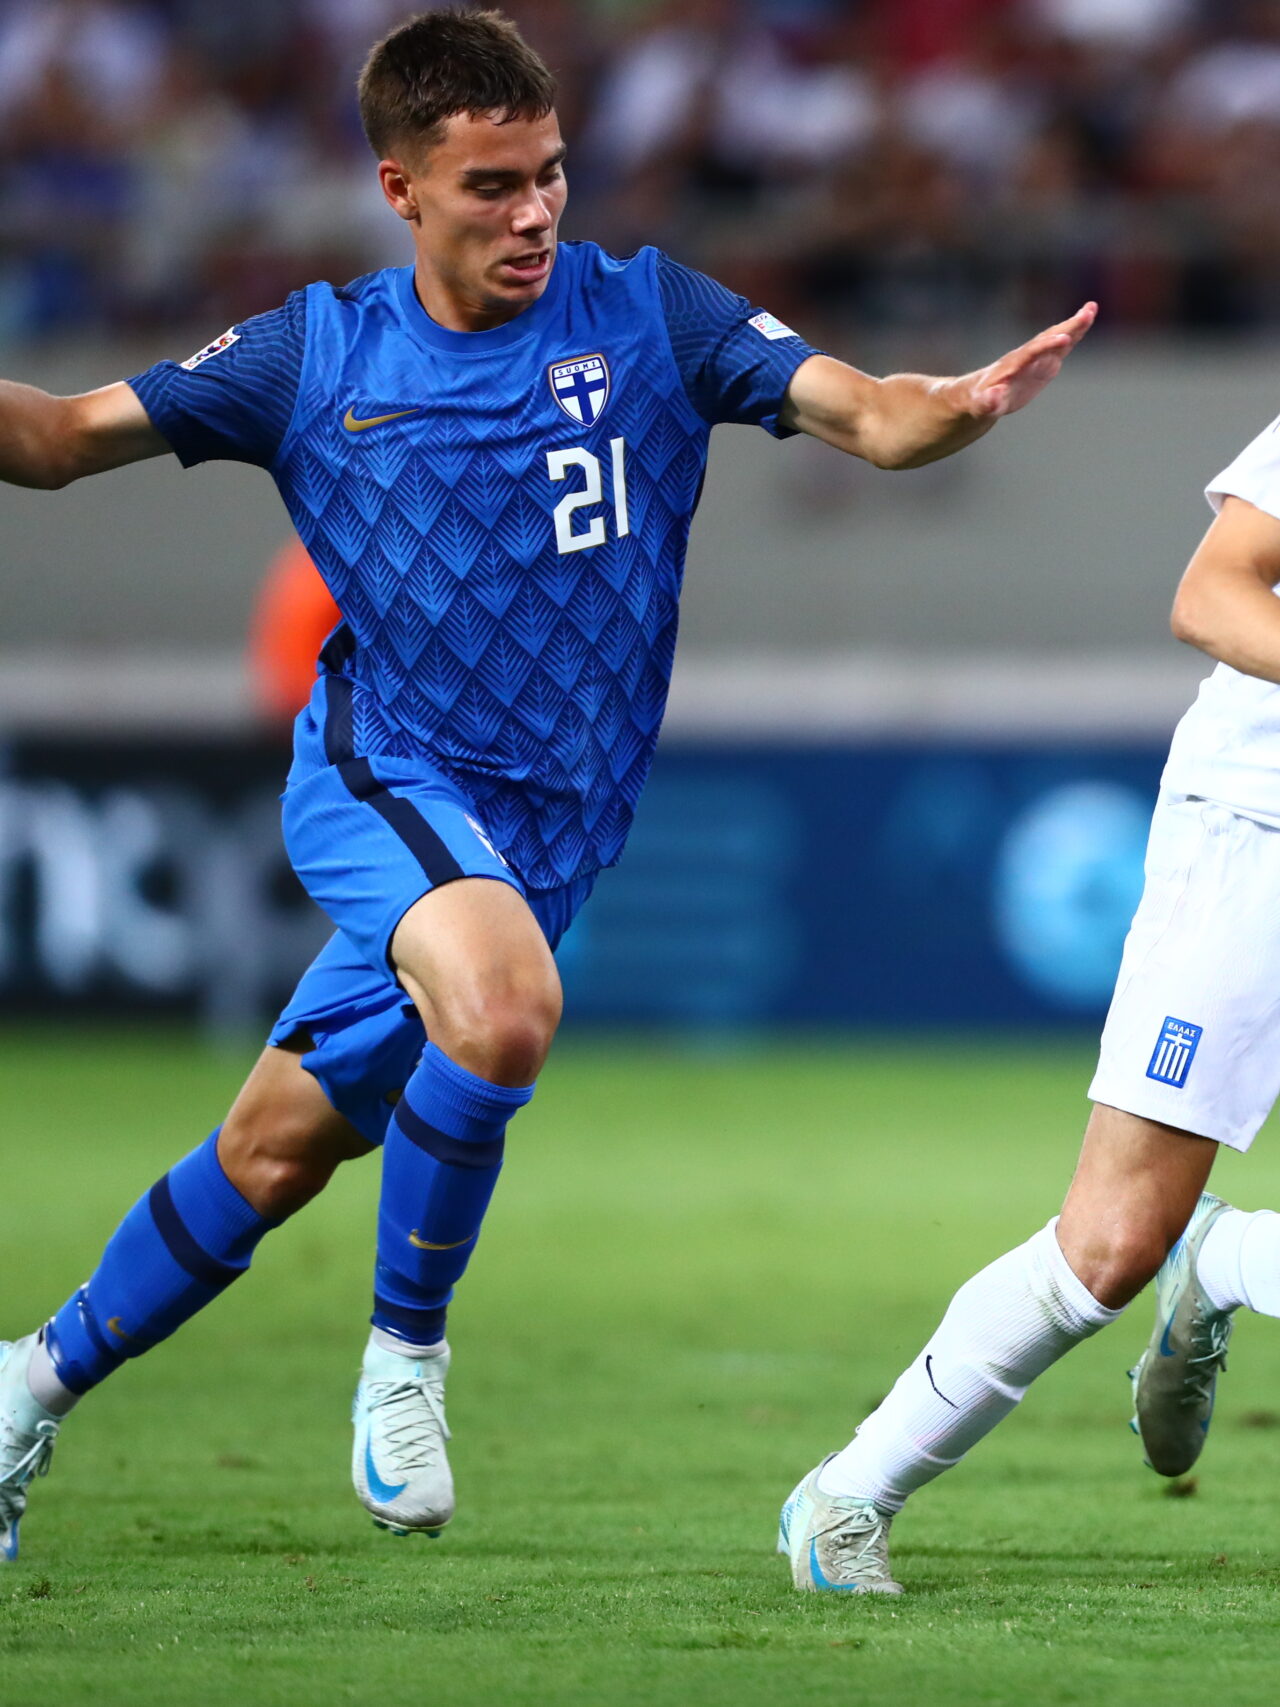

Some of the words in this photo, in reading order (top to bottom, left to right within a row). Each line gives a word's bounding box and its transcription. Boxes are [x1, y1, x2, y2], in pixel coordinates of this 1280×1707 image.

[558, 361, 597, 376] SUOMI
[546, 436, 630, 555] 21
[1167, 1022, 1197, 1037] ΕΛΛΑΣ
